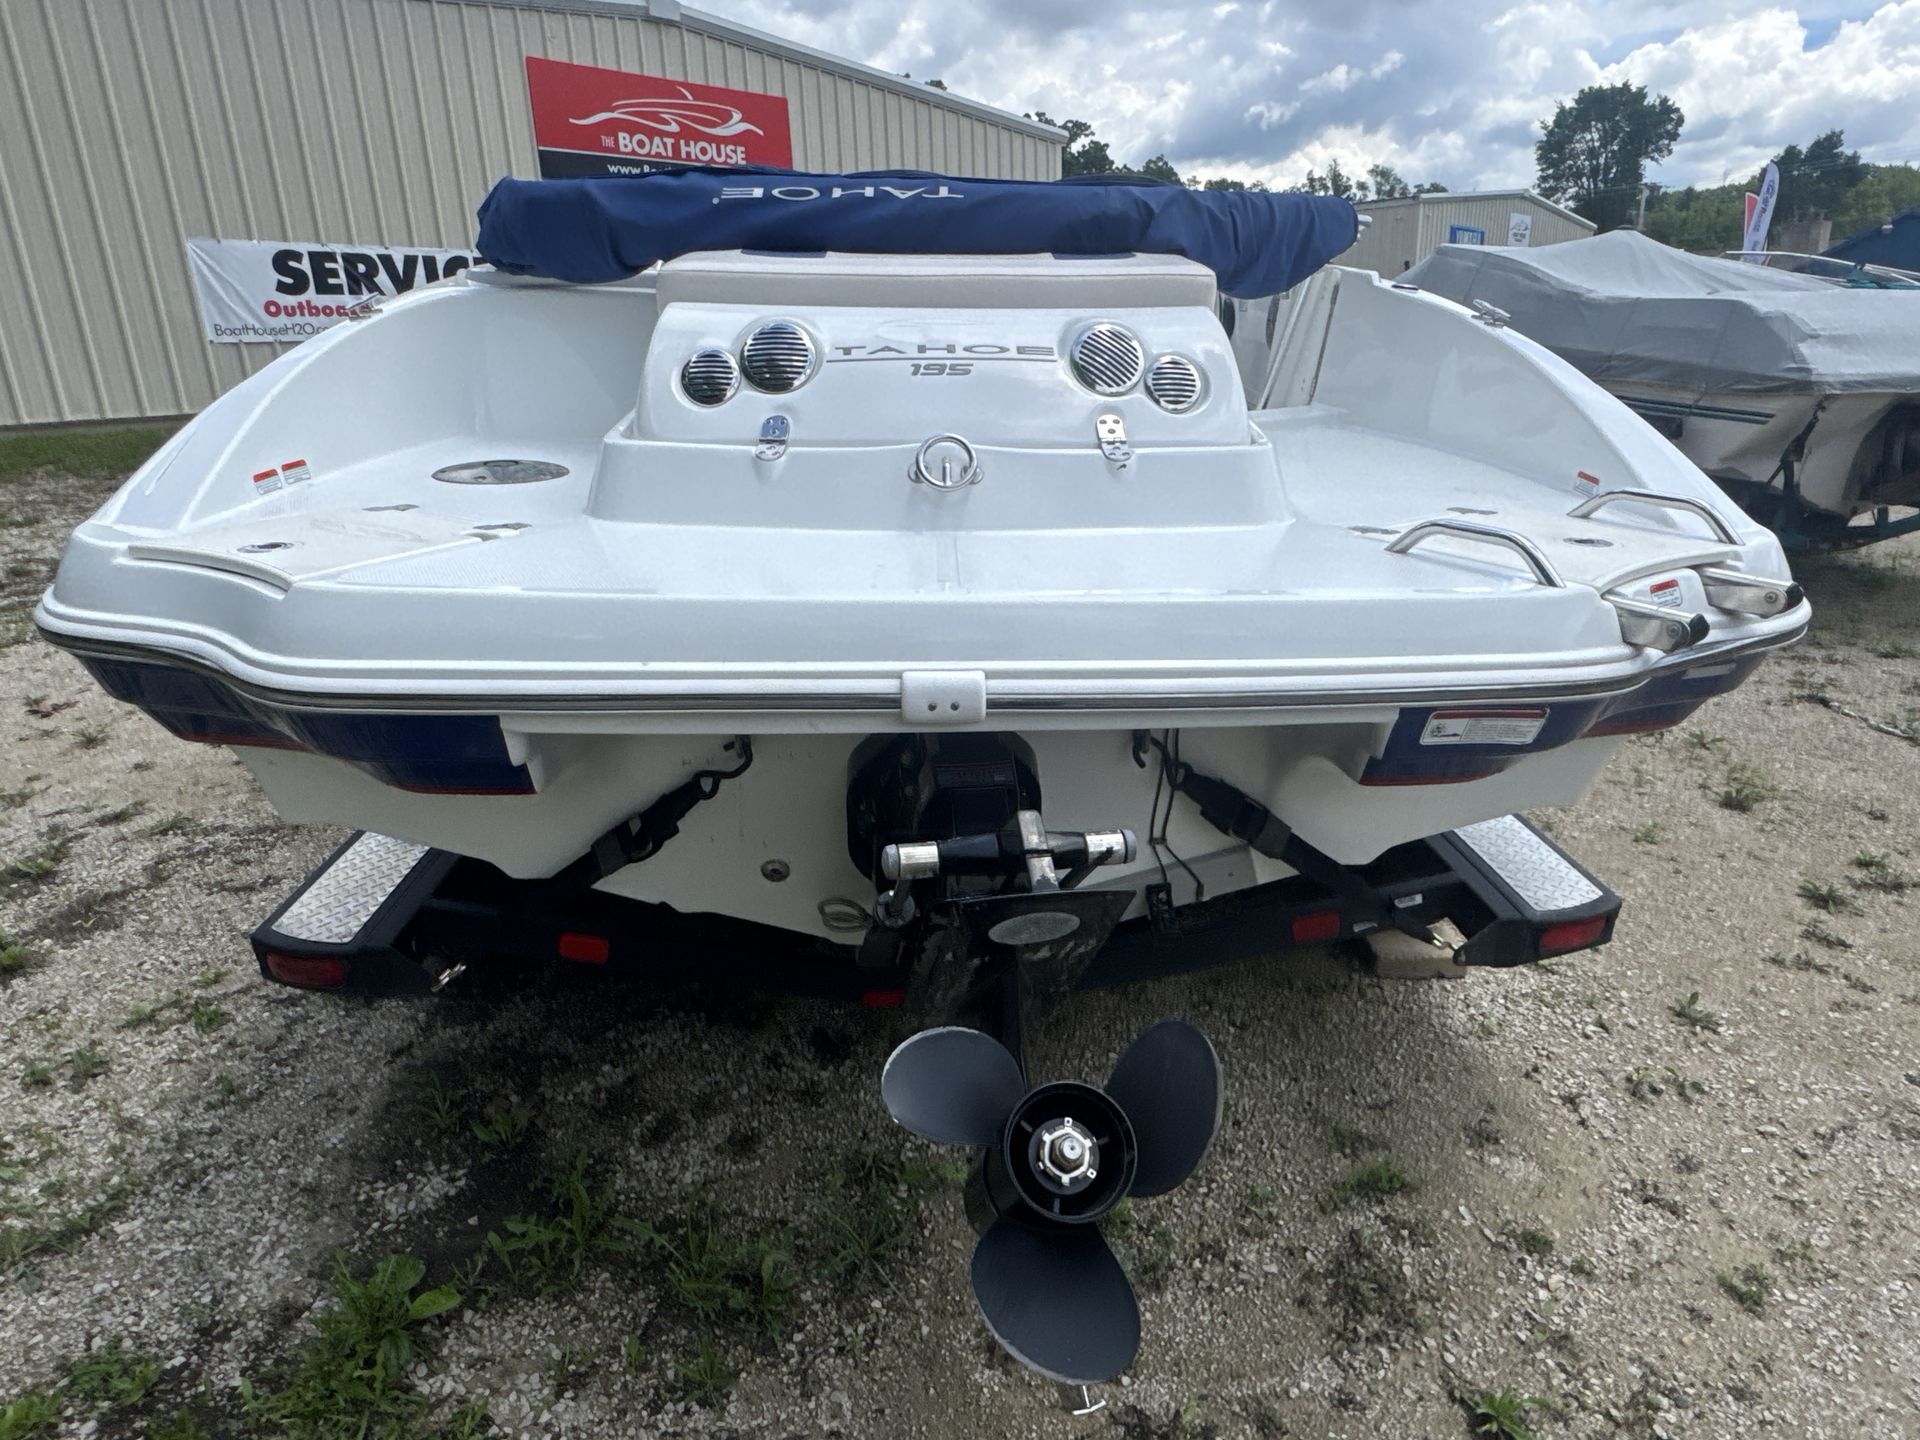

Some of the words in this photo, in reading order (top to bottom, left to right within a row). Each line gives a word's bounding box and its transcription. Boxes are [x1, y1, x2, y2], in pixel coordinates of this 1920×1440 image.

[601, 135, 615, 147] THE
[618, 131, 675, 157] BOAT
[680, 140, 746, 164] HOUSE
[721, 187, 965, 200] TAHOE
[271, 249, 490, 296] SERVIC
[834, 345, 1055, 357] TAHOE
[911, 362, 974, 376] 195
